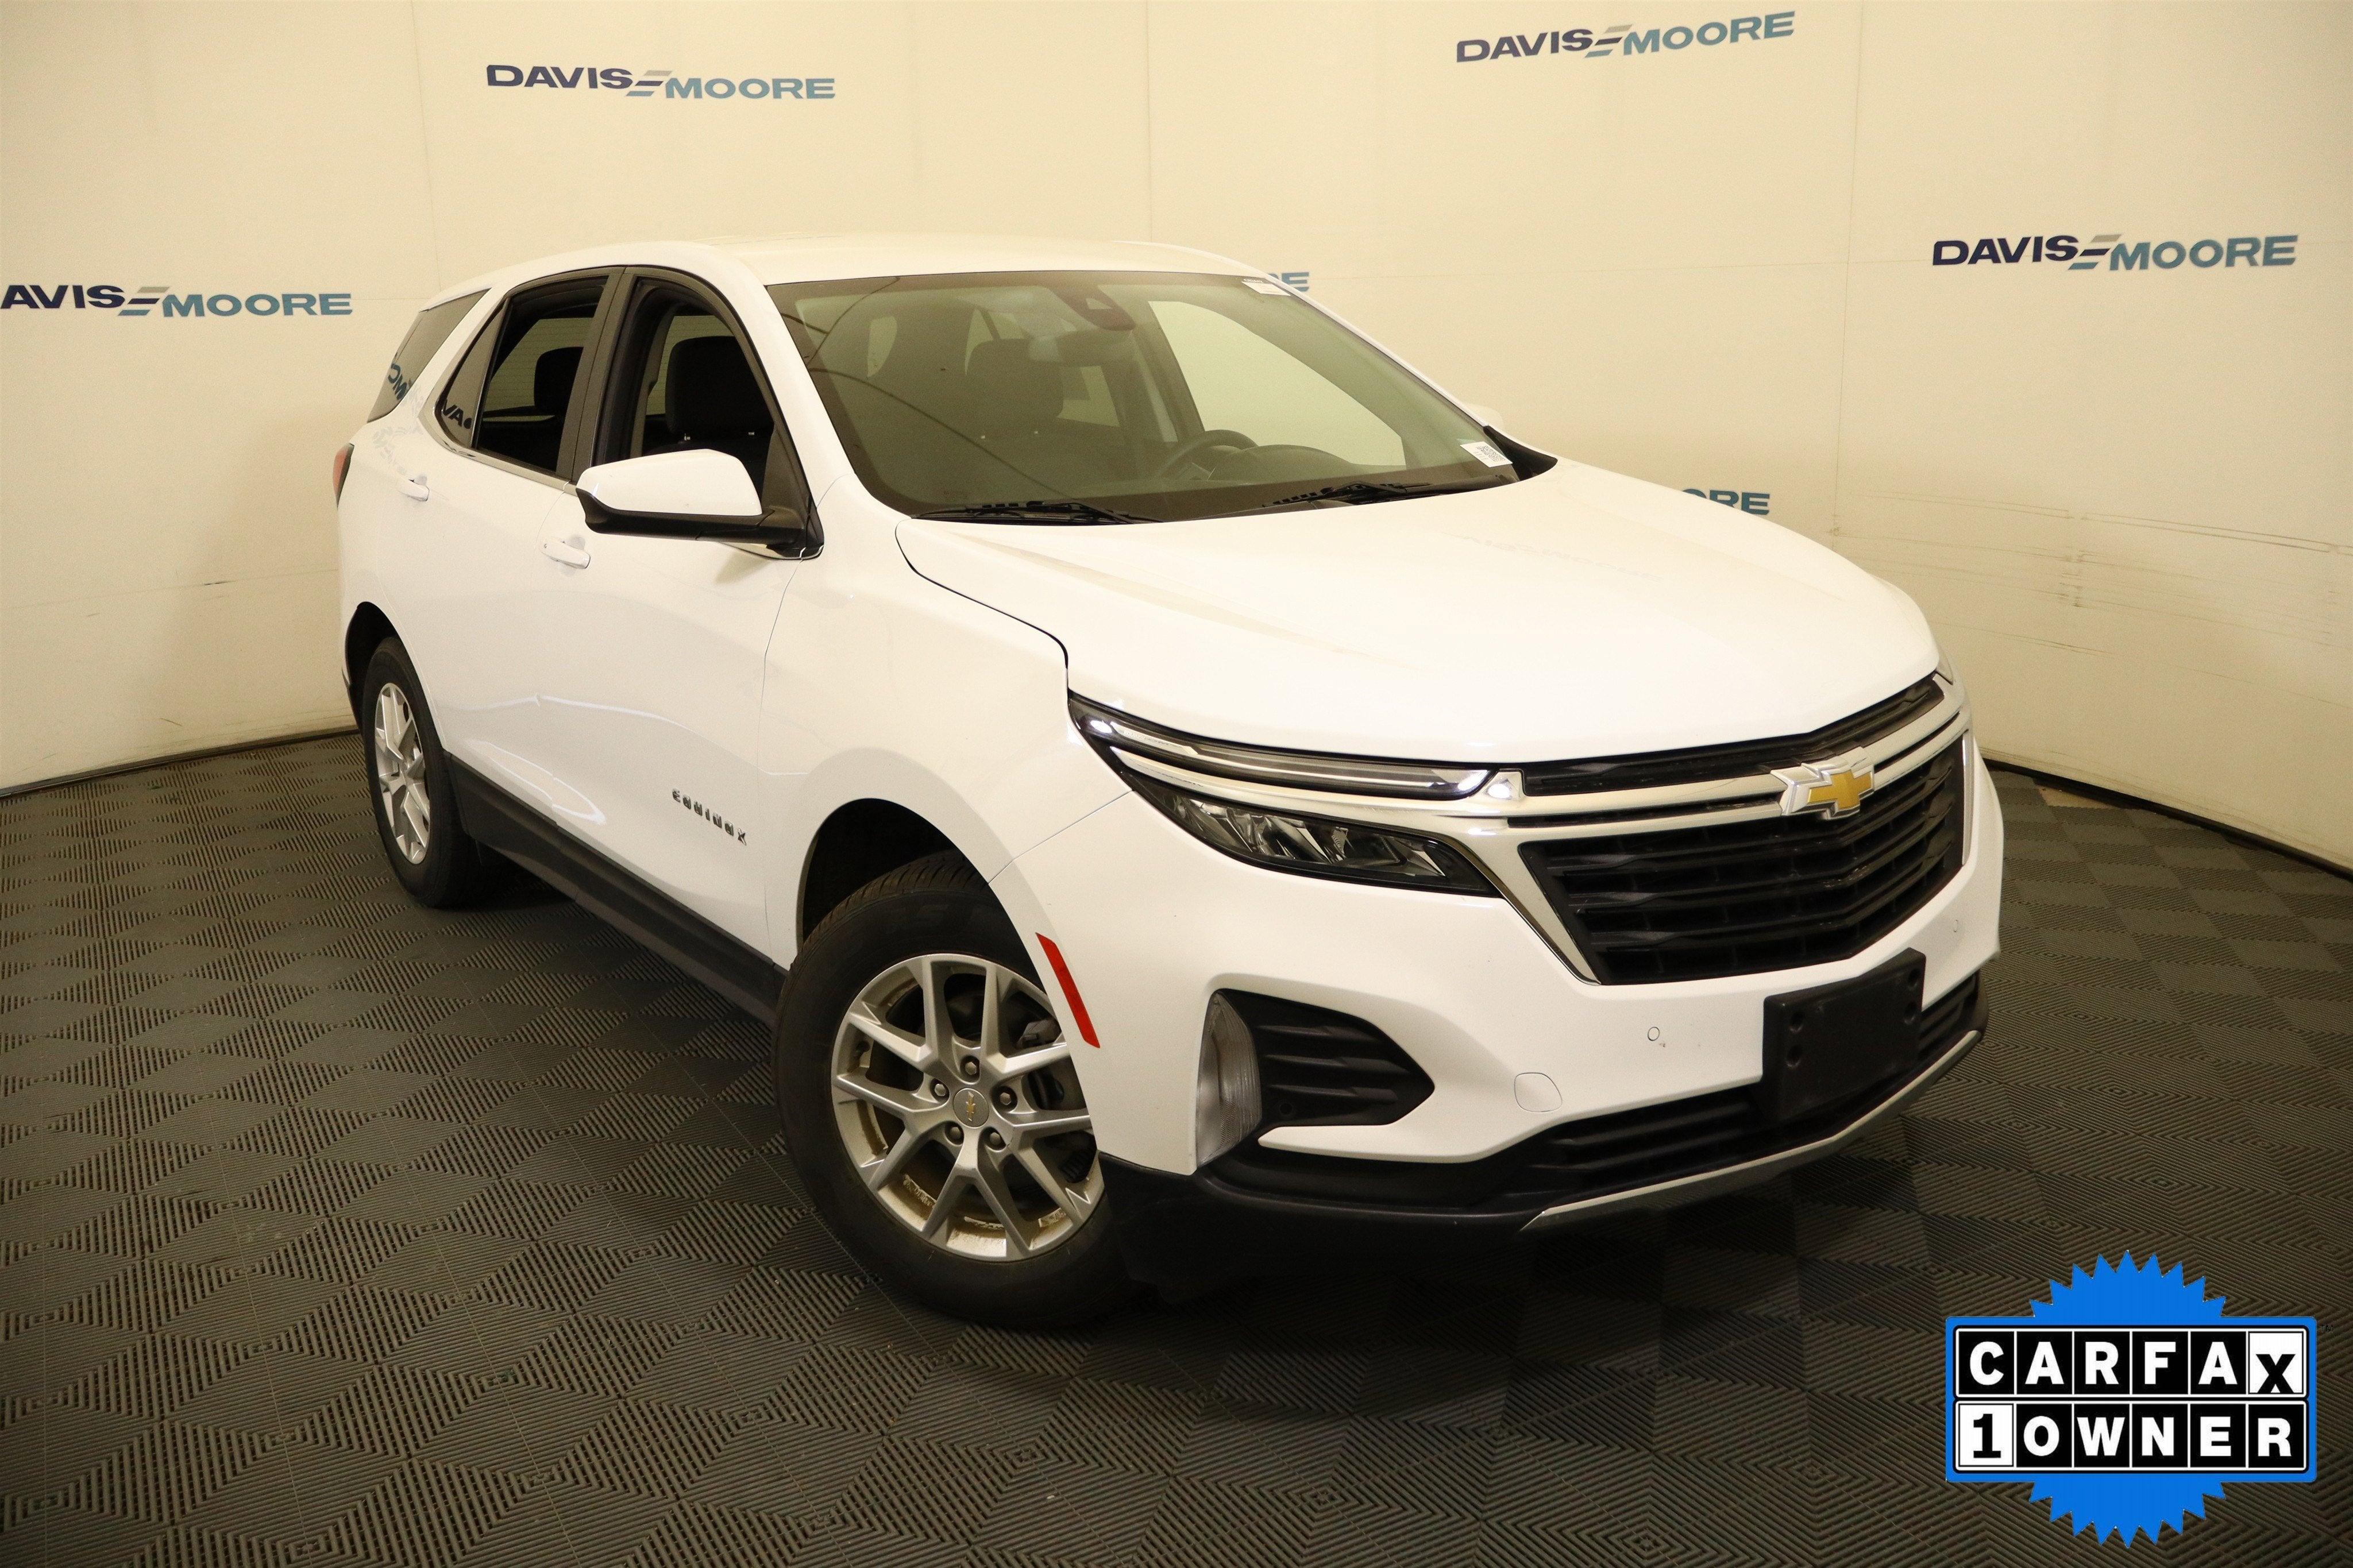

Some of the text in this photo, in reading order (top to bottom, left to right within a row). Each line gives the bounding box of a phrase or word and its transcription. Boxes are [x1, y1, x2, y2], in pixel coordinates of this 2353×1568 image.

[1456, 10, 1796, 63] DAVIS MOORE
[485, 64, 836, 99] DAVIS MOORE
[1932, 234, 2300, 271] DAVIS MOORE
[161, 293, 353, 318] MOORE
